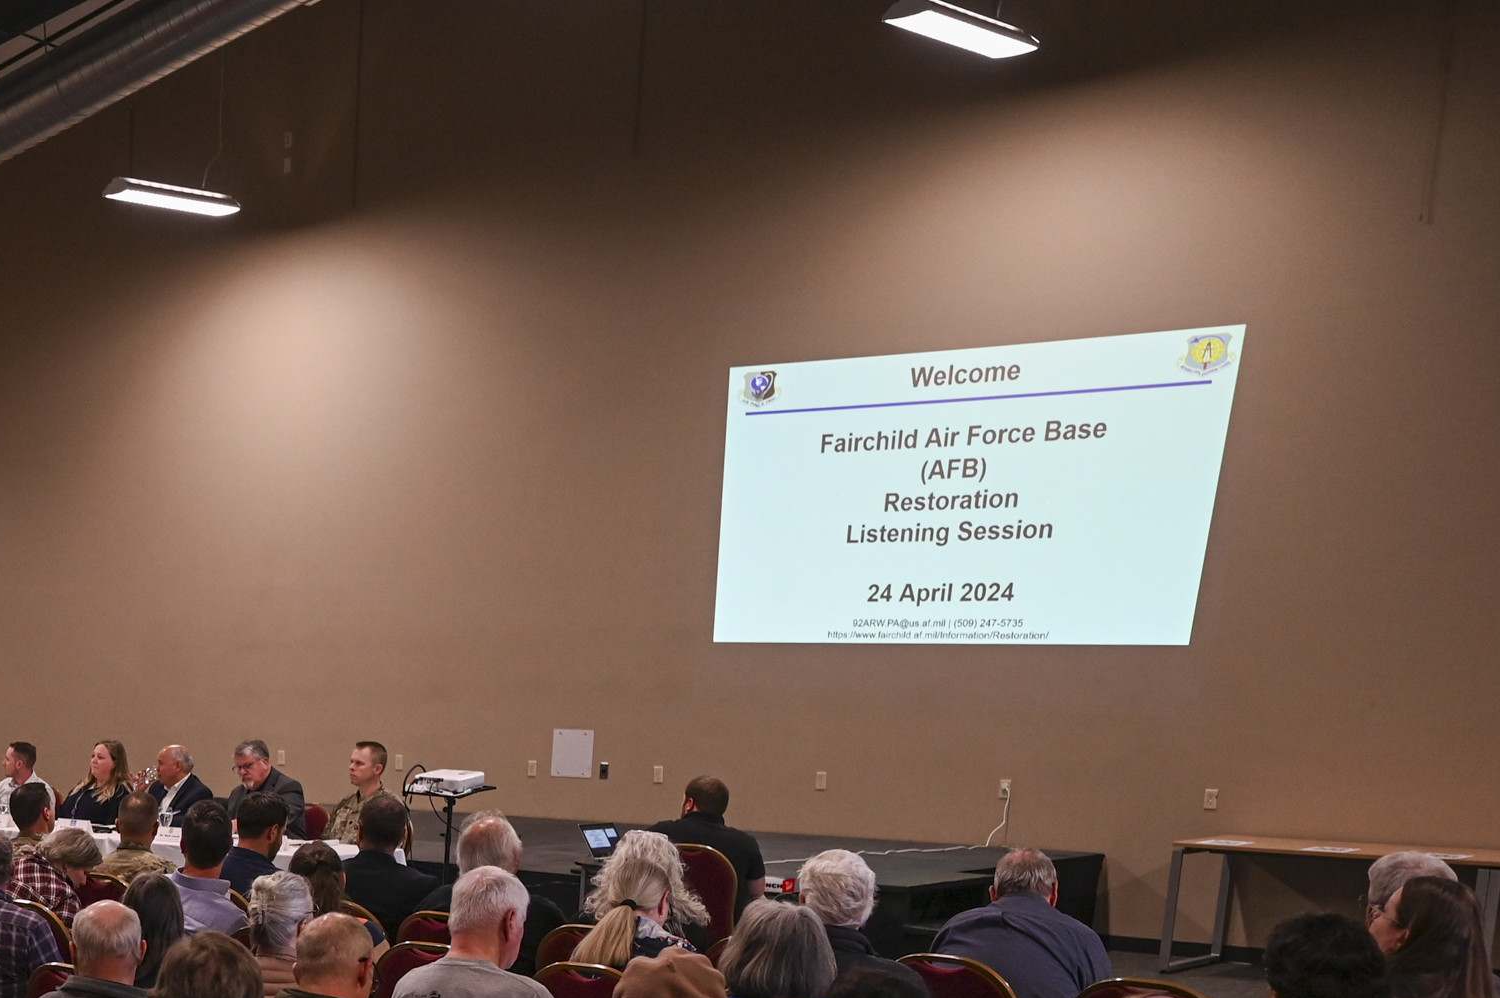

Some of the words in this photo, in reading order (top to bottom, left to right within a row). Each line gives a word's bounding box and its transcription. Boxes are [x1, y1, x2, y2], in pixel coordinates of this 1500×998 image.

[910, 363, 1021, 389] Welcome
[820, 428, 919, 454] Fairchild
[924, 426, 961, 449] Air
[966, 424, 1036, 447] Force
[1043, 419, 1108, 442] Base
[920, 456, 987, 486] (AFB)
[883, 488, 1019, 513] Restoration
[846, 523, 950, 547] Listening
[957, 519, 1054, 542] Session
[866, 583, 893, 603] 24
[898, 582, 954, 608] April
[959, 581, 1015, 603] 2024
[827, 630, 1050, 641] https://www.fairchild.af.mil/Information/Restoration/
[852, 617, 947, 630] 92ARW.PA@us.af.mil
[953, 618, 978, 630] (509)
[979, 618, 1024, 629] 247-5735
